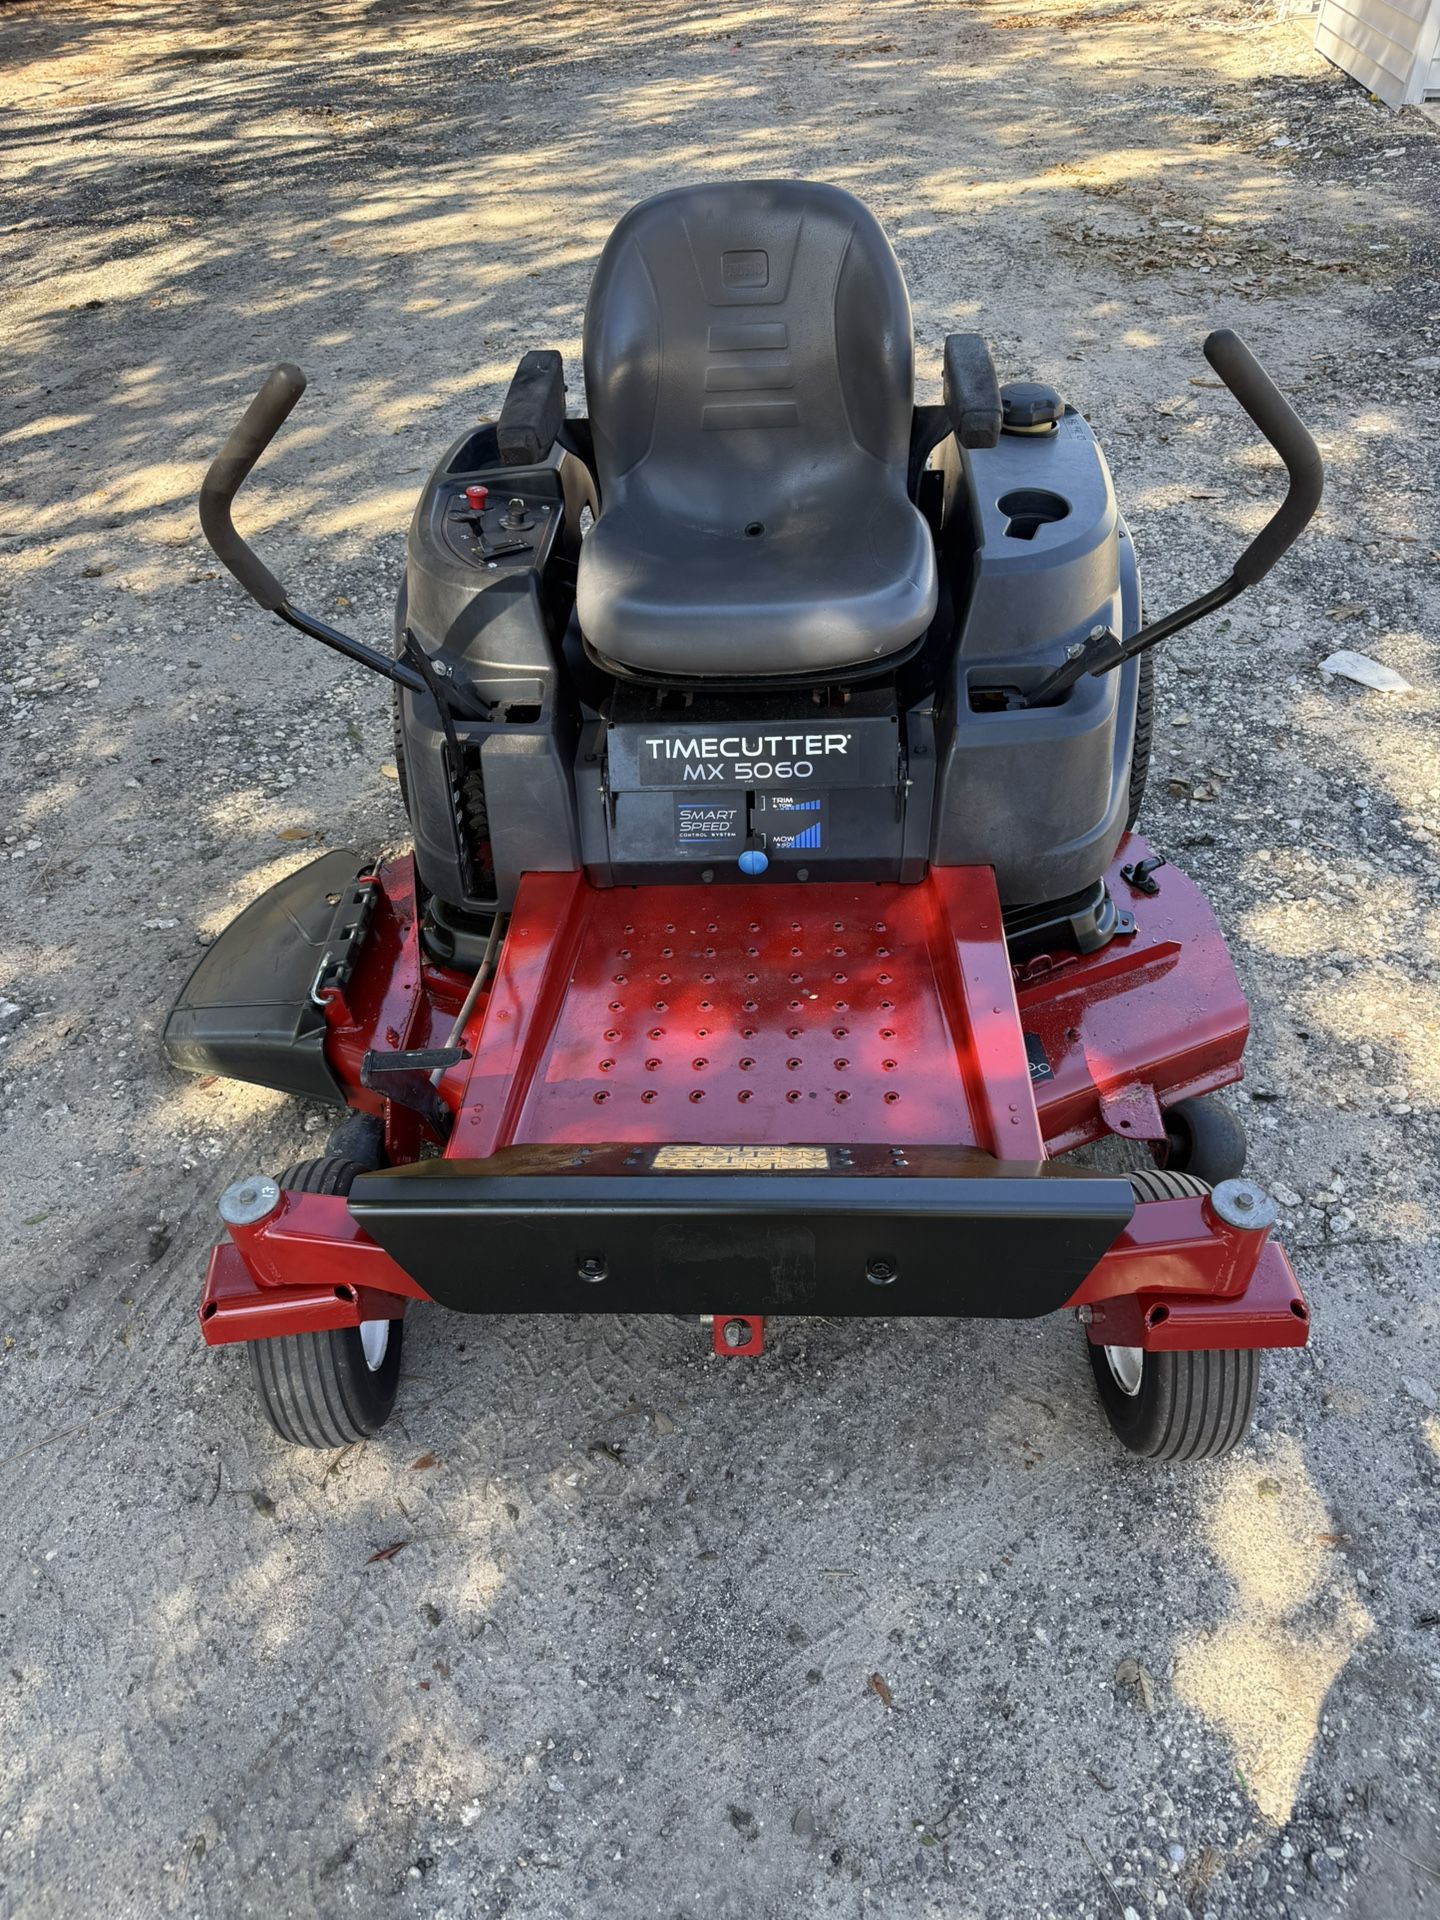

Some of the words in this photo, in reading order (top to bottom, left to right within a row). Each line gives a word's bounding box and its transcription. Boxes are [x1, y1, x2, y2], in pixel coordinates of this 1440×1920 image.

[645, 734, 849, 759] TIMECUTTER
[683, 763, 724, 780] MX
[735, 761, 813, 779] 5060
[680, 810, 737, 820] SMART
[680, 821, 730, 832] SPEED
